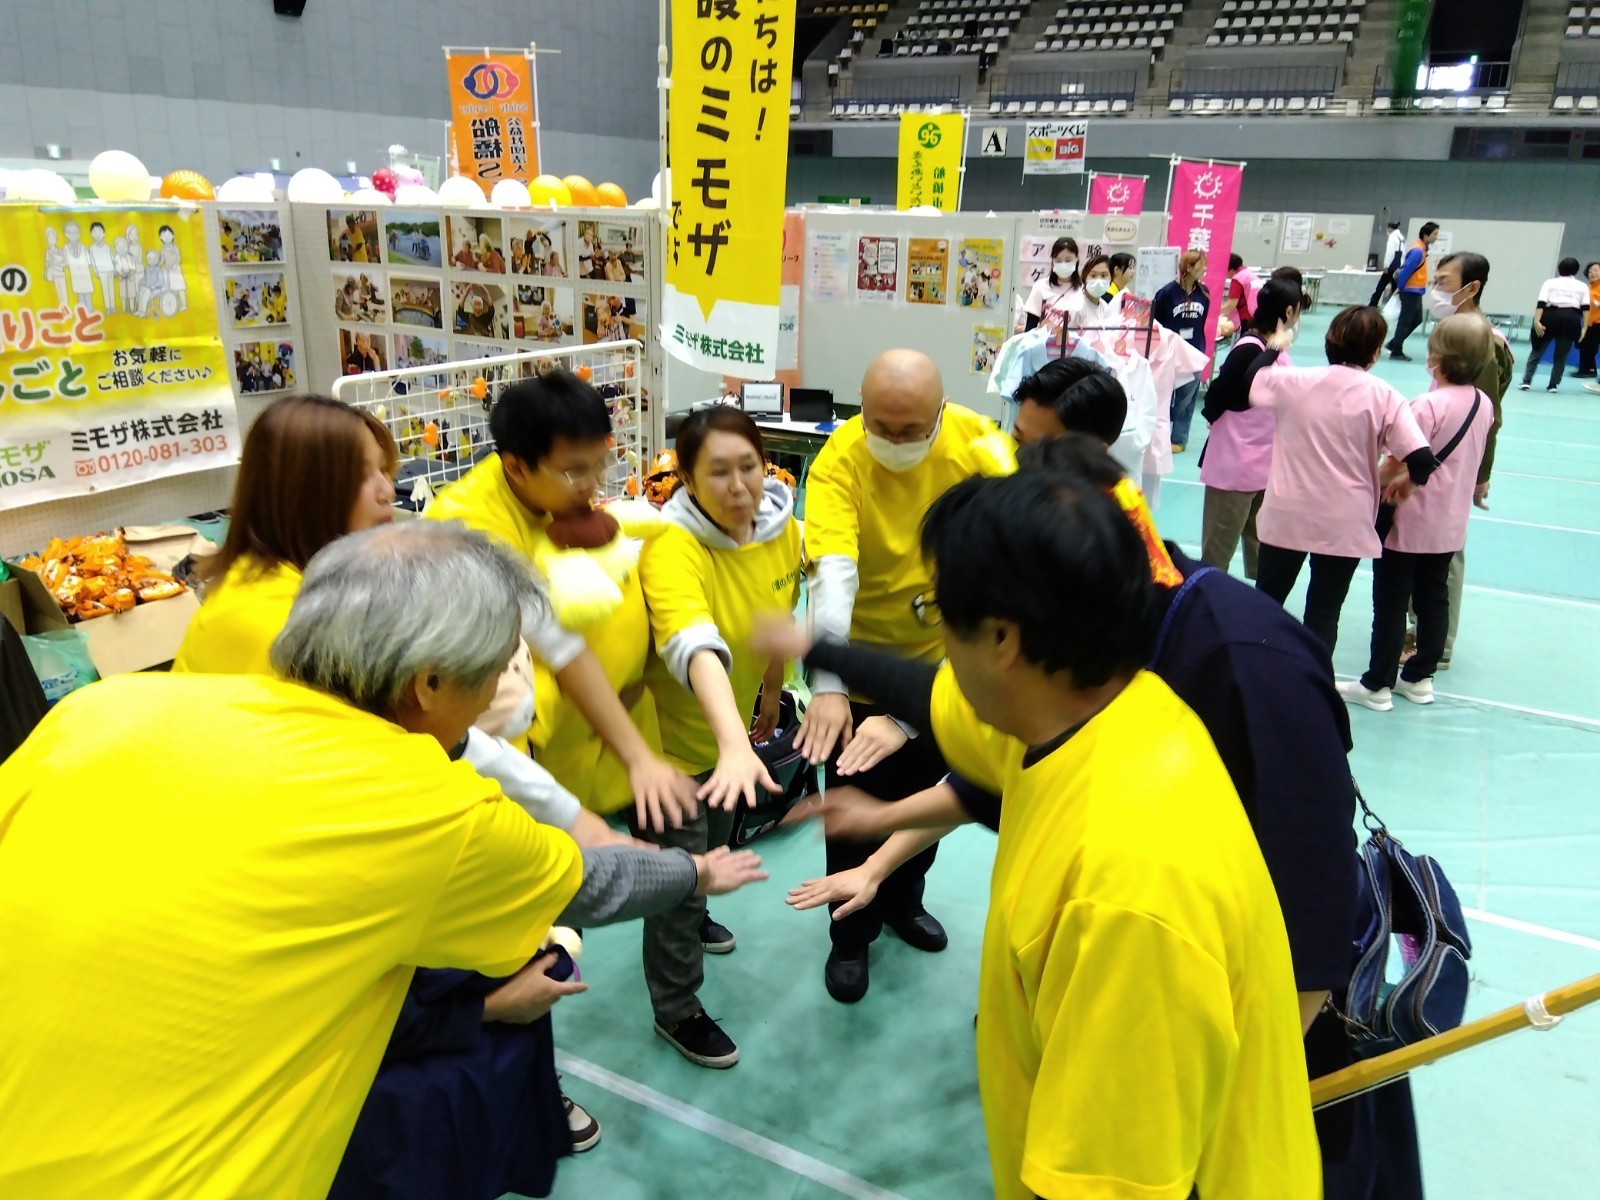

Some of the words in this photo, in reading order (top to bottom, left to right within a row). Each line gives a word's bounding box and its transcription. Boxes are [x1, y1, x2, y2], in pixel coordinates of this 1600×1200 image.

[750, 0, 779, 141] ちは！
[983, 129, 1004, 153] A
[1028, 122, 1086, 137] スポーツくじ
[1, 267, 27, 292] の
[113, 345, 182, 367] お気軽に
[672, 323, 765, 364] ミモザ株式会社
[0, 357, 87, 400] ごと
[71, 408, 224, 452] ミモザ株式会社
[0, 439, 51, 469] モザ
[98, 434, 228, 473] 0120-081-303
